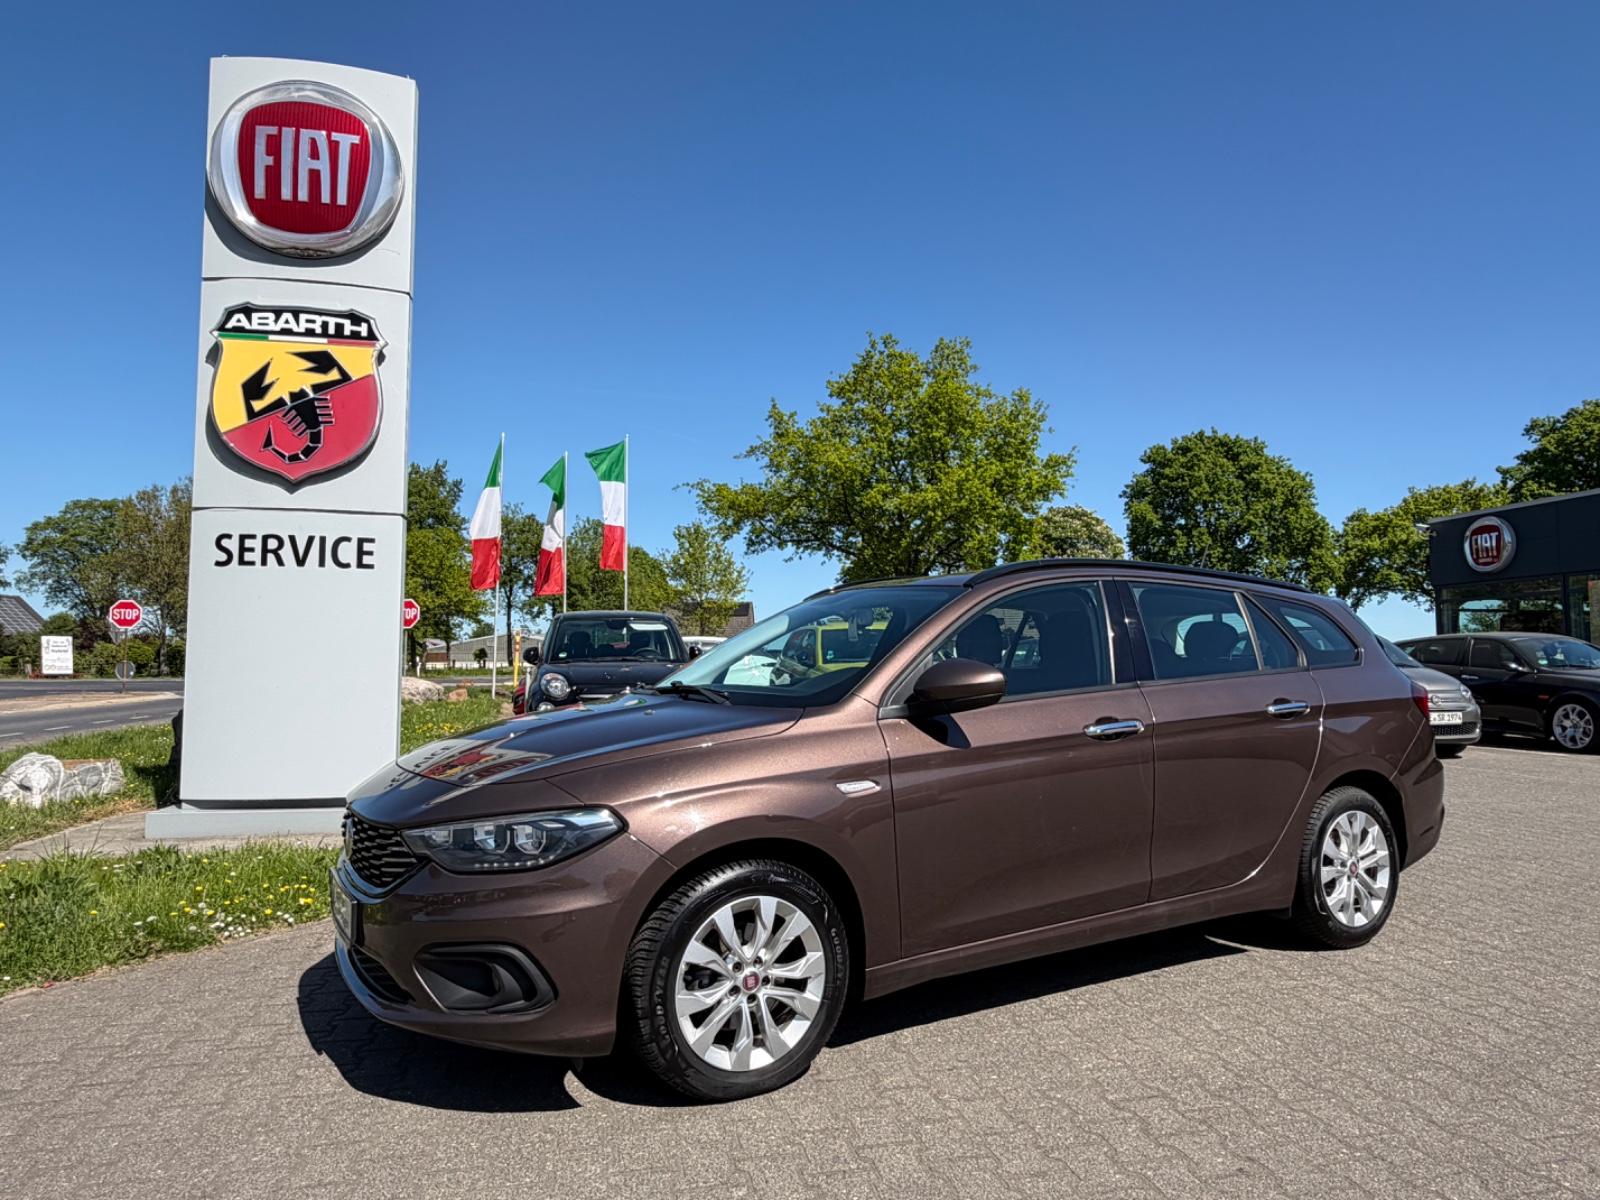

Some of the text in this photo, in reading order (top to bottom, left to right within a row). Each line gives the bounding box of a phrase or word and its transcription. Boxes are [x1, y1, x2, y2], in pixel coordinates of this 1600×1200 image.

[254, 125, 360, 206] FIAT
[225, 312, 368, 337] ABARTH
[214, 533, 376, 569] SERVICE
[1472, 531, 1498, 559] FIAT
[113, 608, 139, 620] STOP
